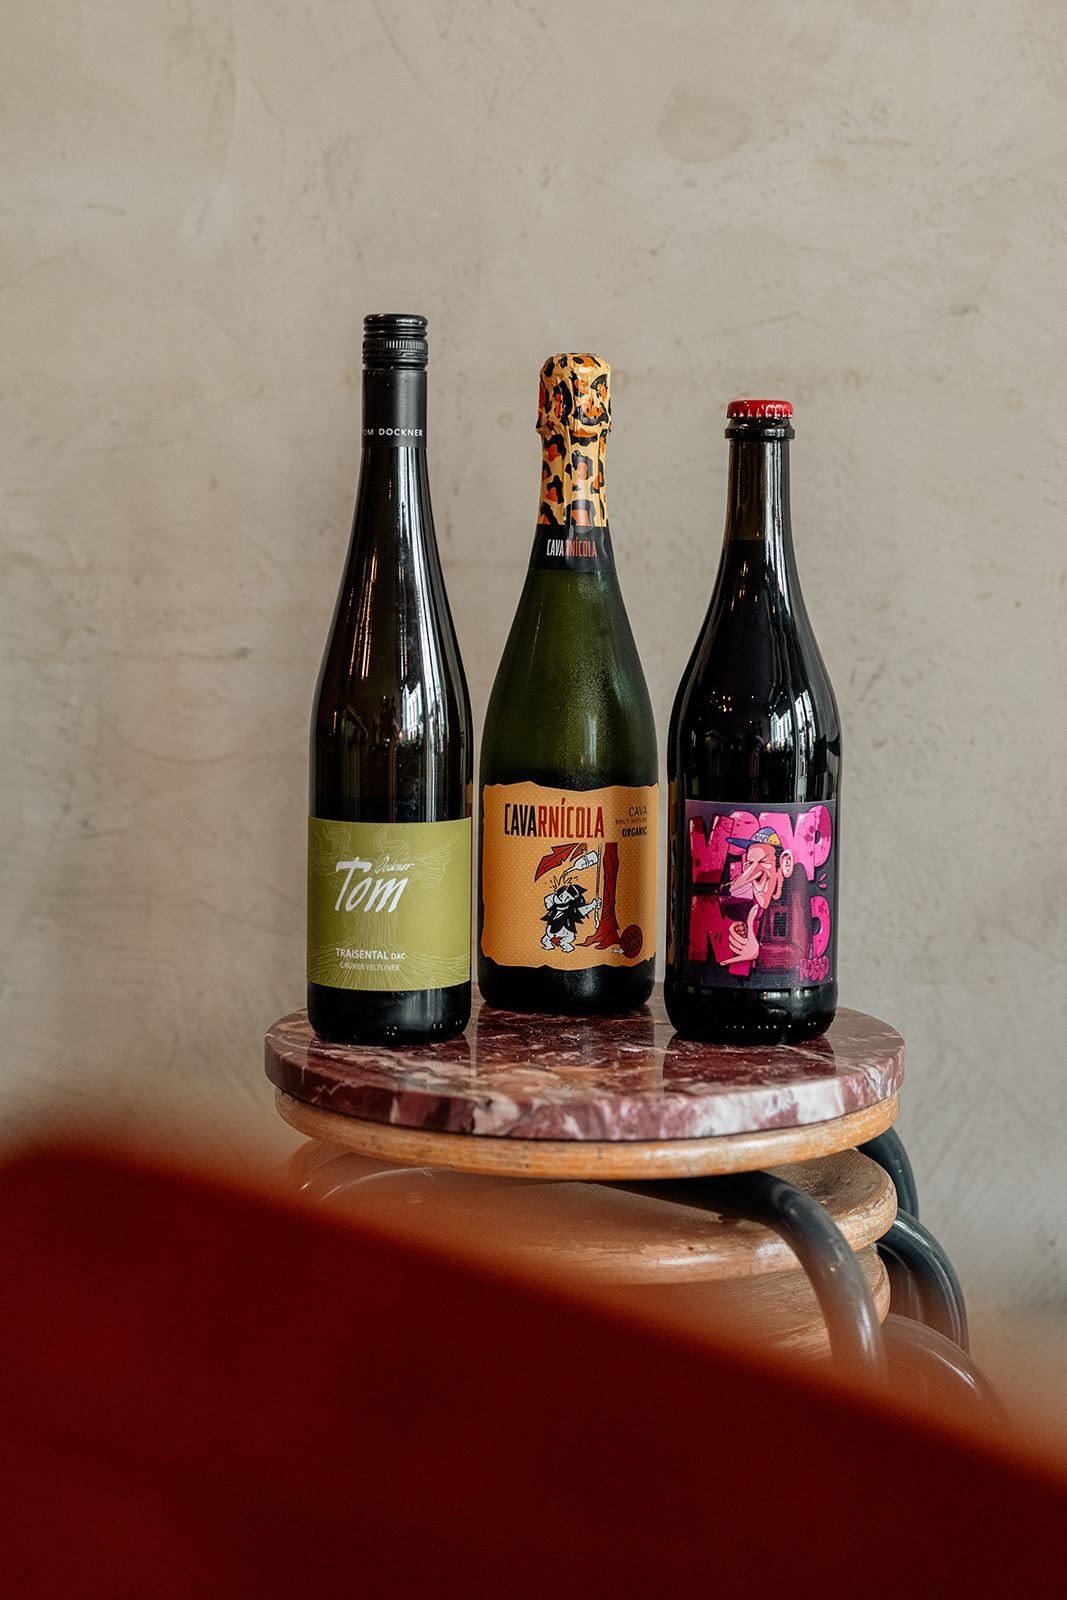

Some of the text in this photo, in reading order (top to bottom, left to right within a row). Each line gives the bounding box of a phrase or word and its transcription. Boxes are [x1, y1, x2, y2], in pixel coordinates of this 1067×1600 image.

[362, 428, 423, 437] OM DOCKNER
[628, 805, 648, 817] CAVA
[504, 797, 605, 839] CAVARNÍCOLA
[622, 826, 647, 838] ORGANIC
[334, 856, 409, 913] Tom
[335, 947, 406, 961] TRAISENTAL DAC
